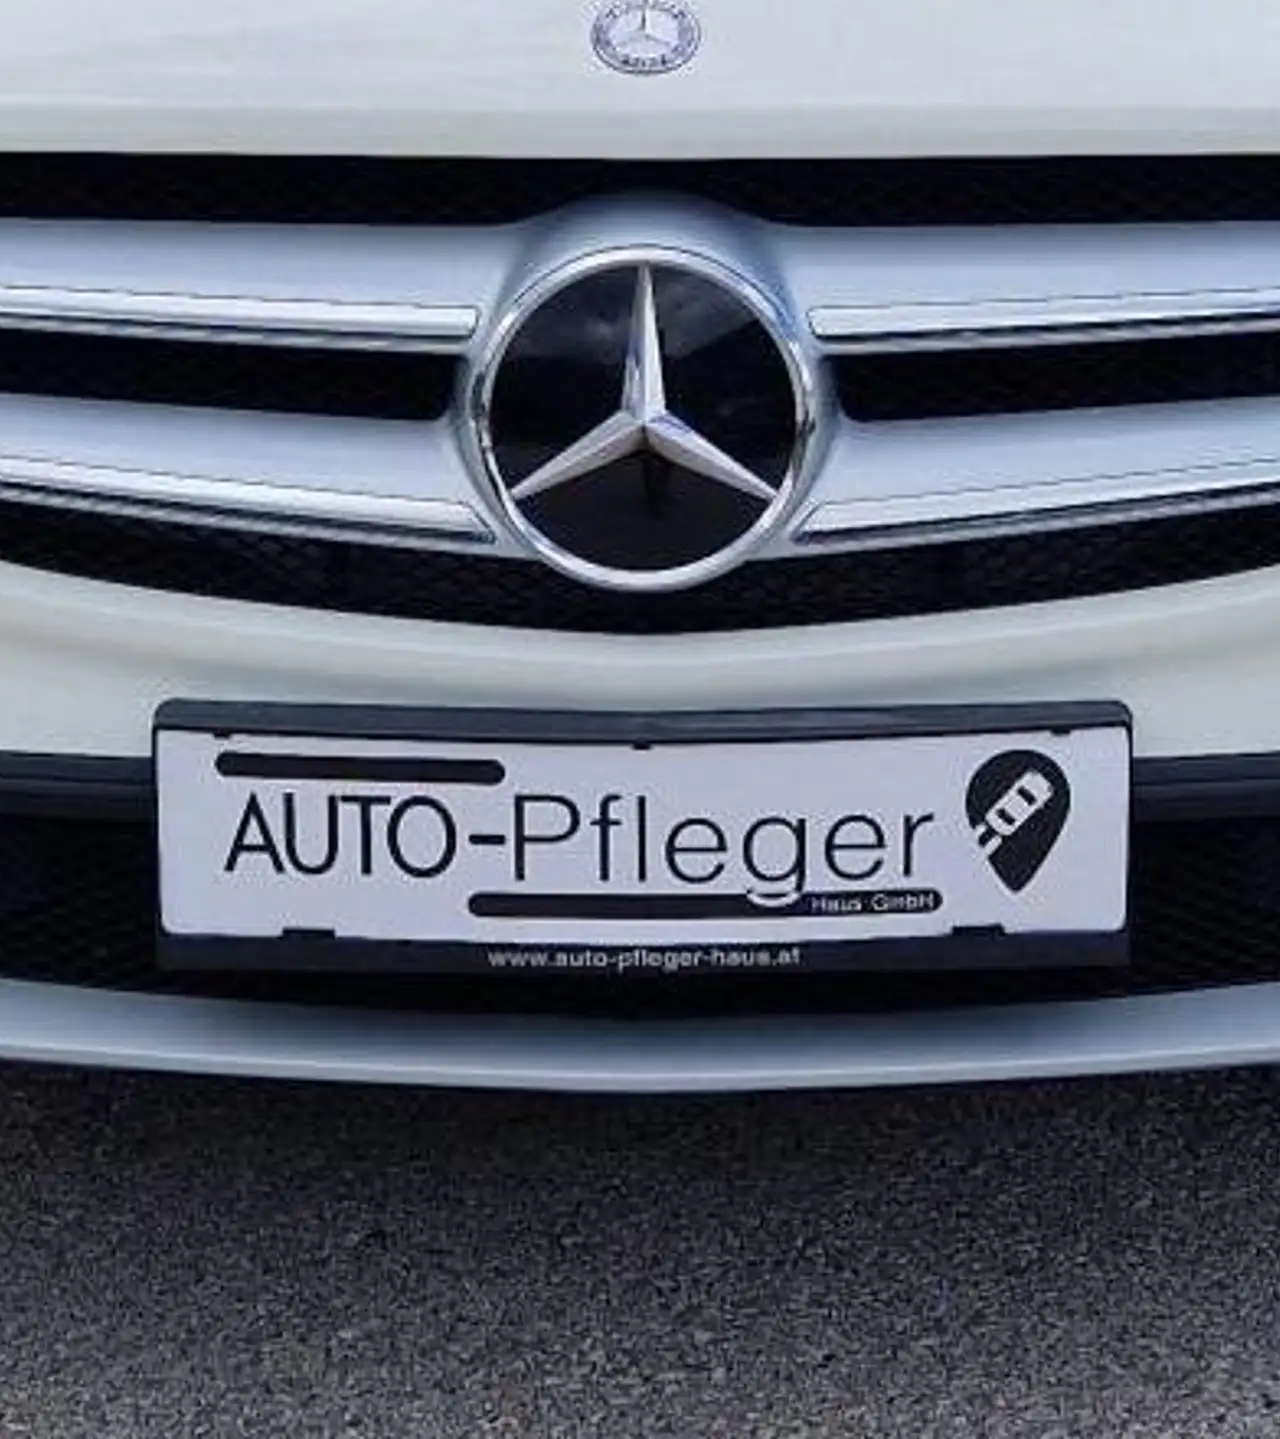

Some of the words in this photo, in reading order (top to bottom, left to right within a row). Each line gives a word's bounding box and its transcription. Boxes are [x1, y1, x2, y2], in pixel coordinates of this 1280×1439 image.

[224, 791, 934, 907] AUTO-Pfleger
[873, 893, 935, 911] GmbH
[487, 947, 802, 973] www.auto-pfleger-haus.at
